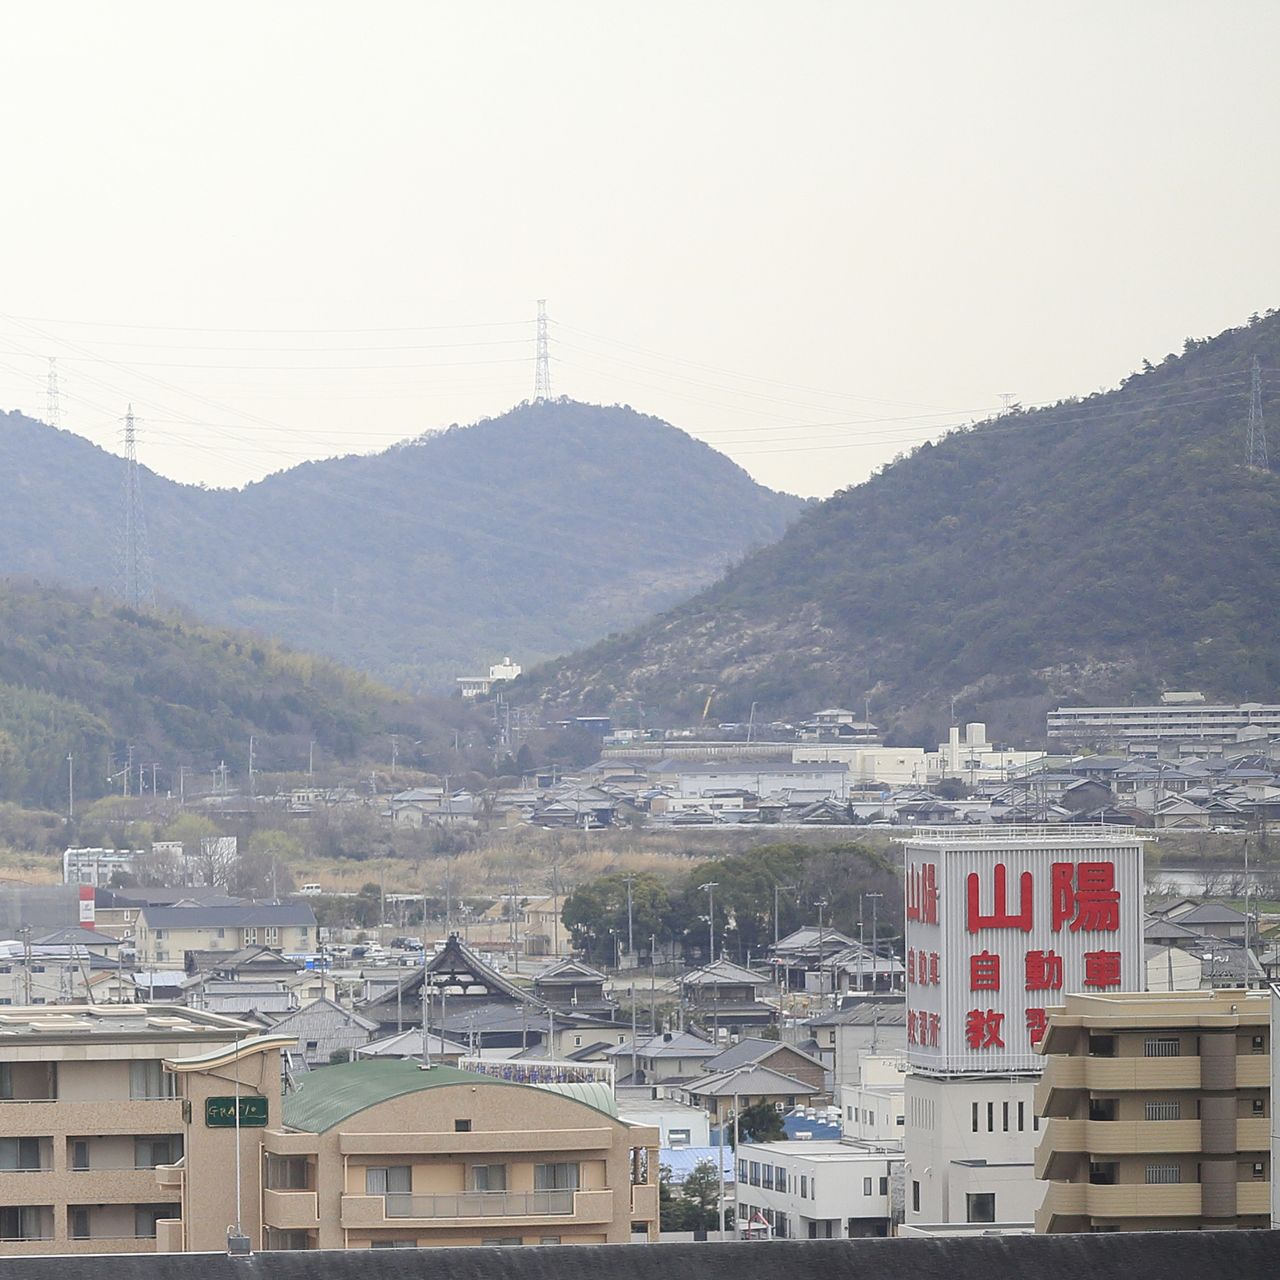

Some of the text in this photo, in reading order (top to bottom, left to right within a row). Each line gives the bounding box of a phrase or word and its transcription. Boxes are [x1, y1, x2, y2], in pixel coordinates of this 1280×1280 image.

[967, 862, 1121, 934] 山陽
[970, 950, 1121, 992] 自動車
[208, 1104, 266, 1118] GRAIO
